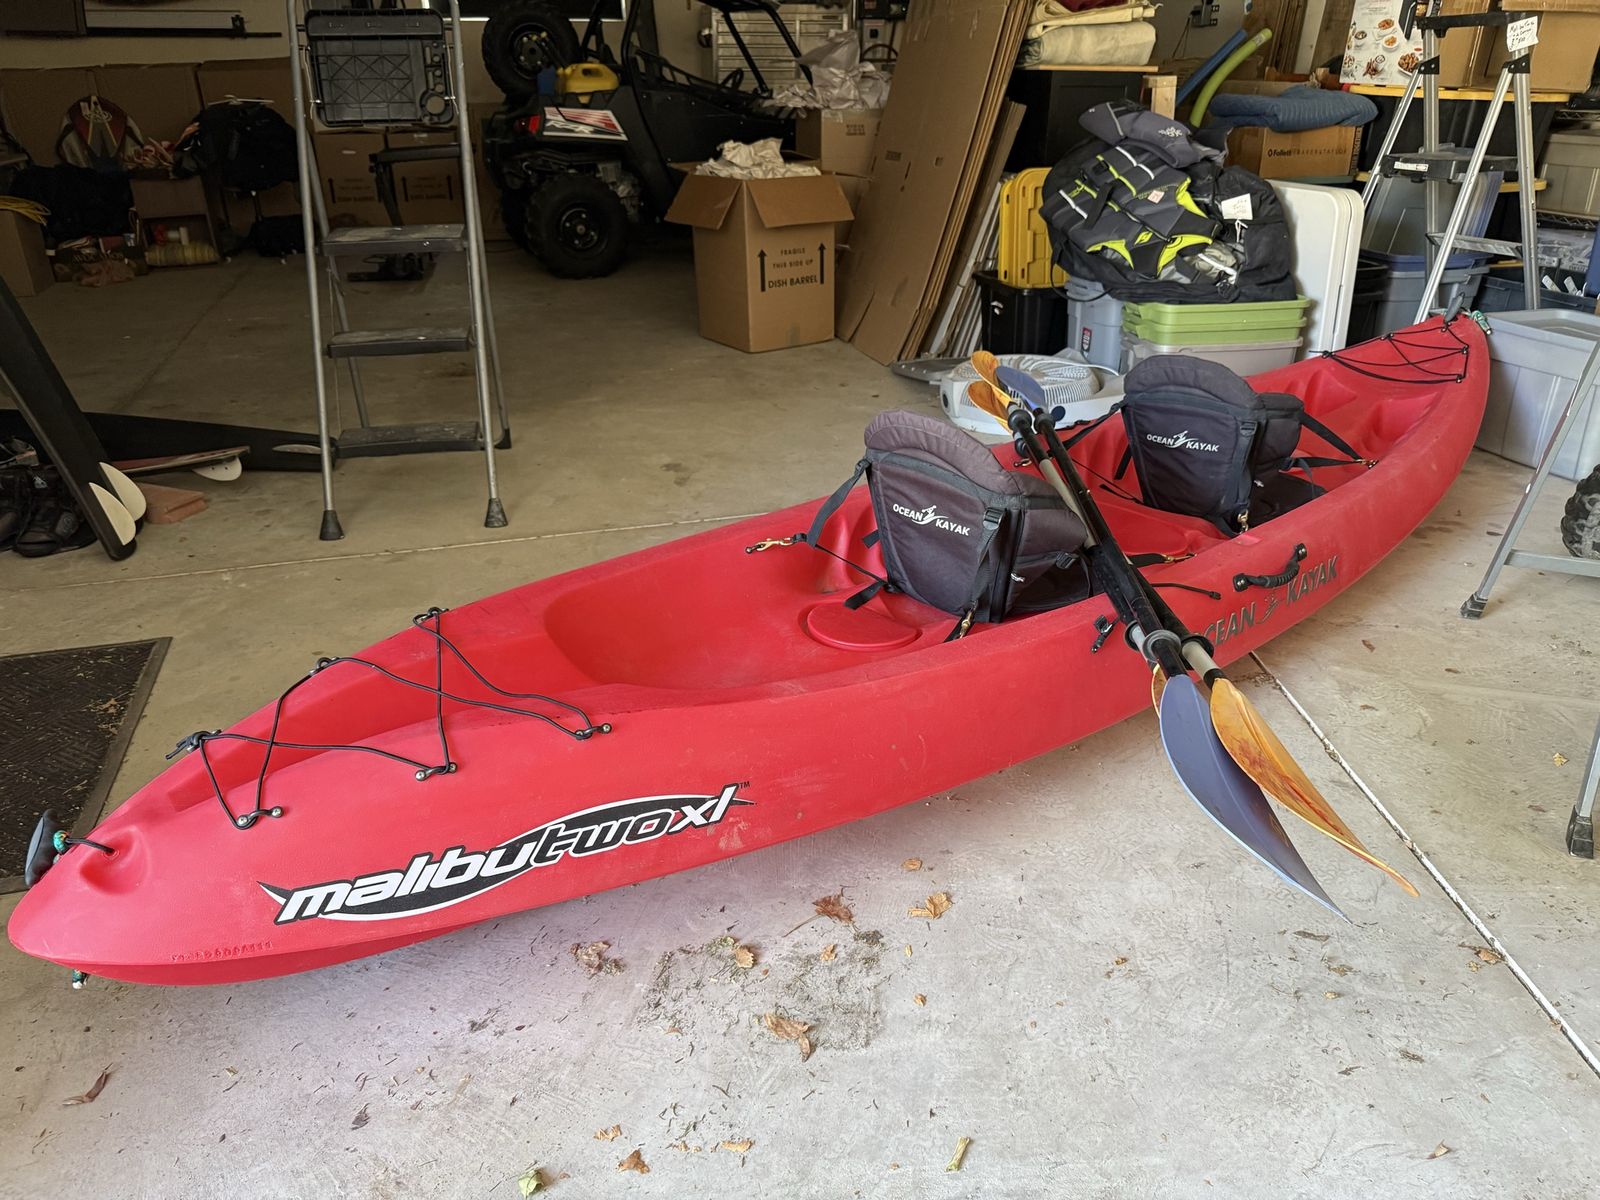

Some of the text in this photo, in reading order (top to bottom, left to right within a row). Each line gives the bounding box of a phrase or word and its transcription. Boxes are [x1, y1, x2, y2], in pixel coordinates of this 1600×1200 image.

[1273, 149, 1292, 157] Follett
[780, 248, 806, 256] FRAGILE
[768, 275, 818, 288] DISH BARREL
[1146, 433, 1220, 452] OCEAN KAYAK
[892, 503, 971, 536] OCEAN KAYAK
[1194, 555, 1338, 646] CEAN KAYAK
